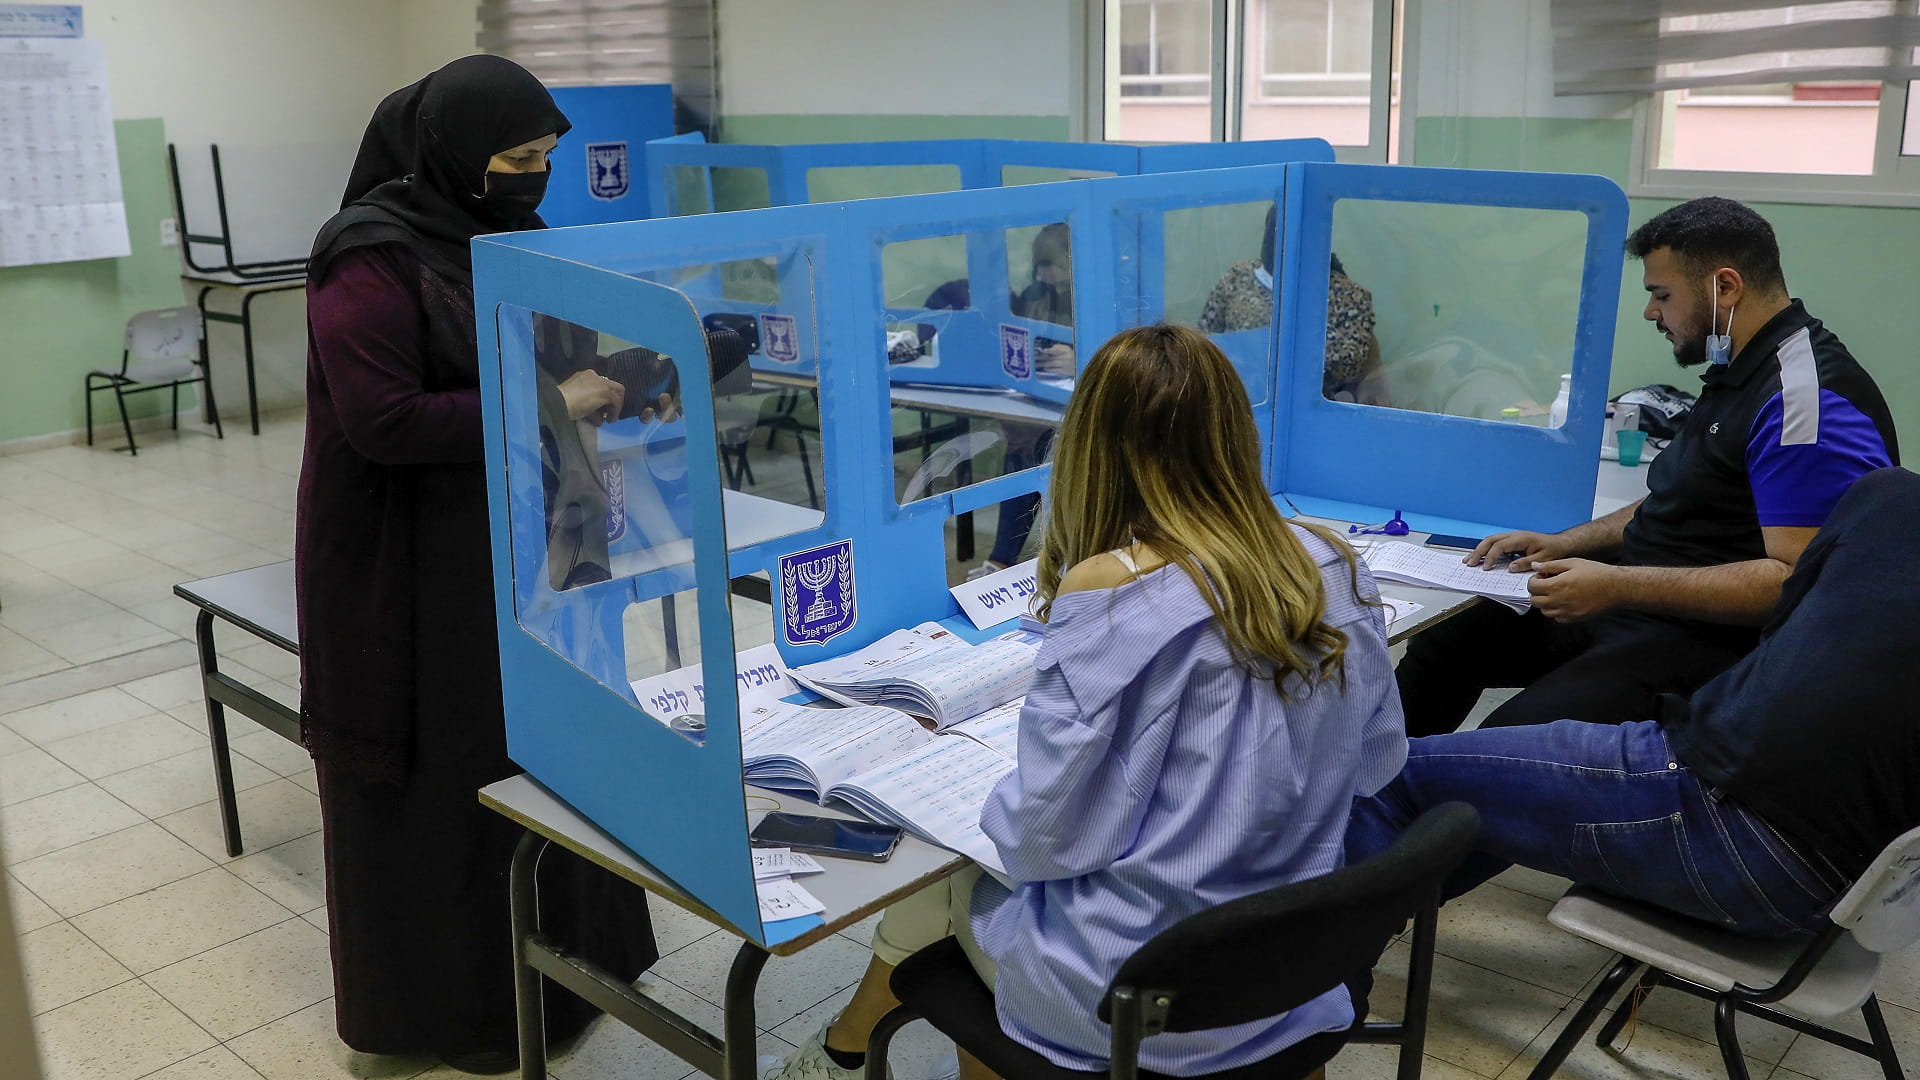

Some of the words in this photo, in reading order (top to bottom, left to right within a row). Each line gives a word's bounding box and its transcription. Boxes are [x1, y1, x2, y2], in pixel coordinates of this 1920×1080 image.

[978, 586, 1014, 609] ראש
[1011, 575, 1036, 597] שב
[800, 621, 842, 639] ישראל
[737, 664, 780, 689] מזכיר
[650, 687, 689, 713] קלפי
